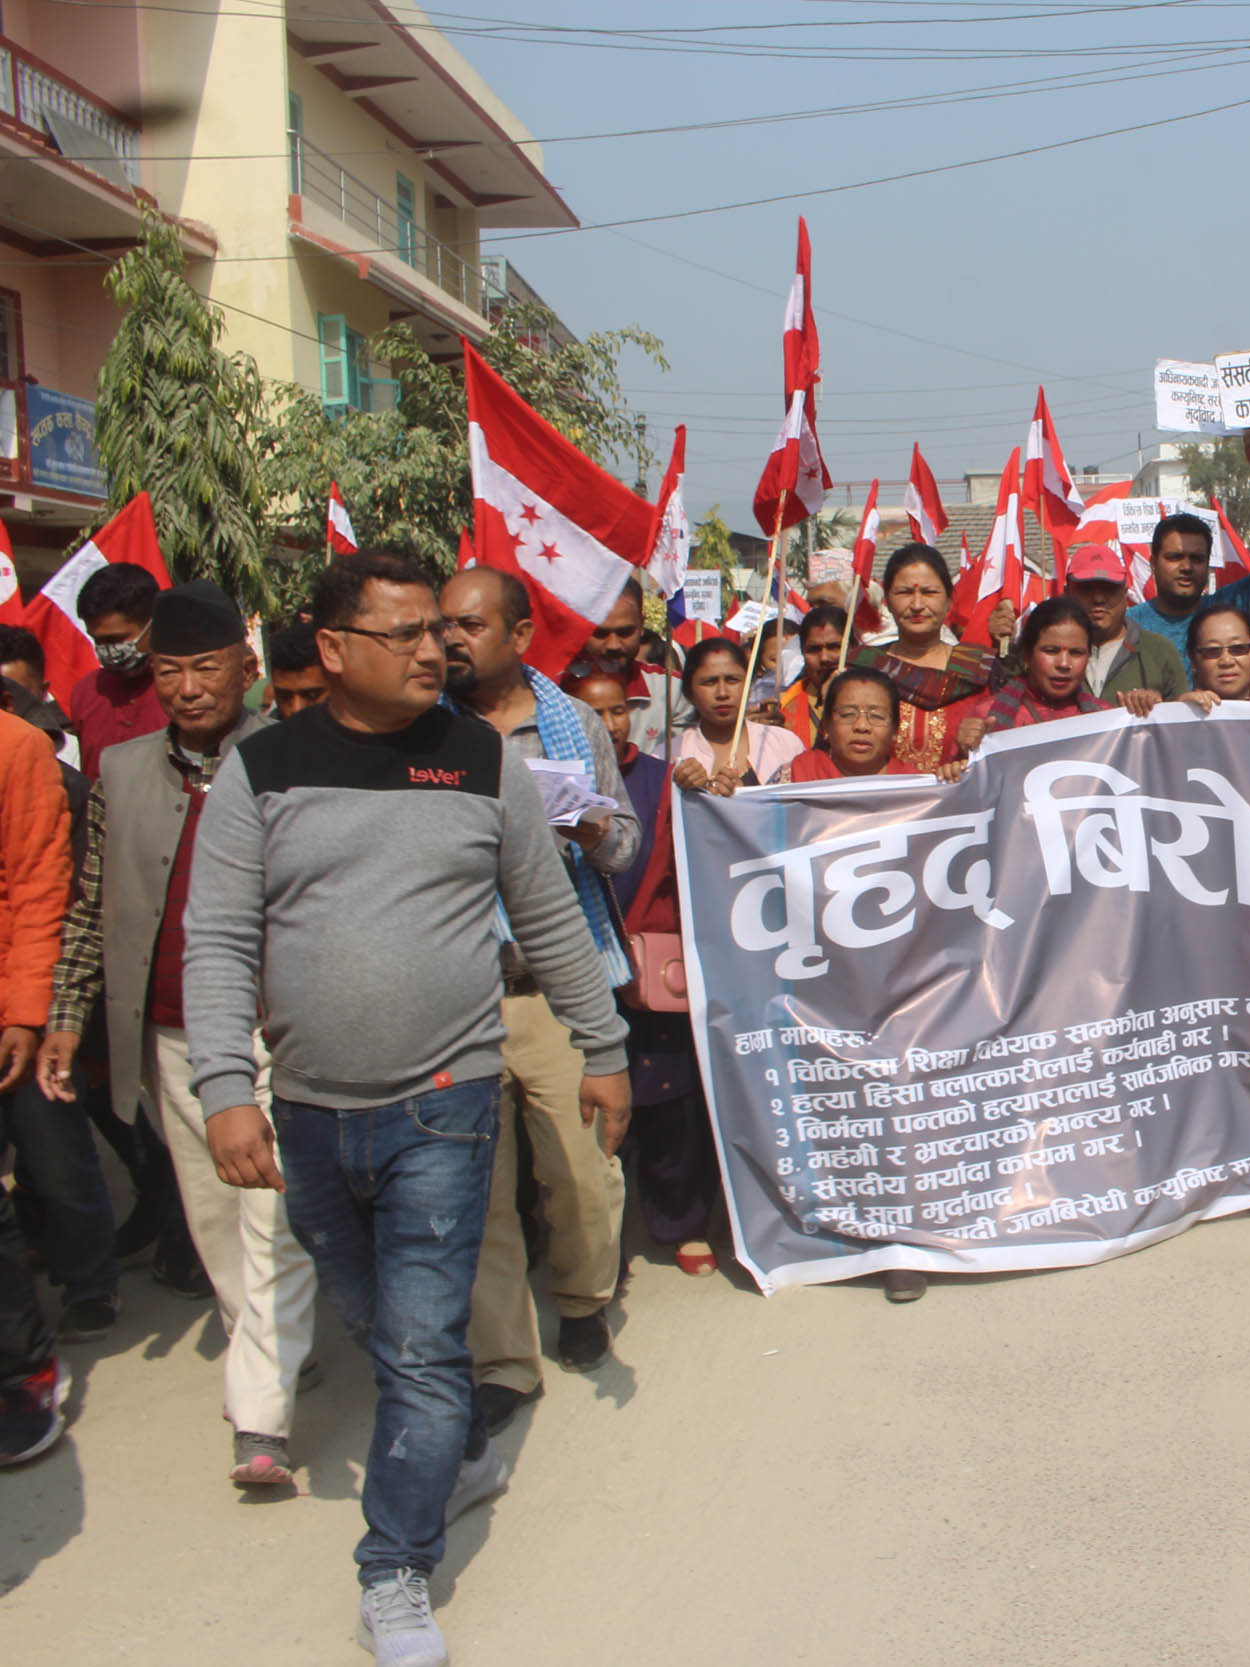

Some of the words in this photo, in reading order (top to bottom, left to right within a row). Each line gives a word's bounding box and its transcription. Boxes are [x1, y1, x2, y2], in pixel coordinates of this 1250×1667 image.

[787, 1057, 899, 1084] चिकित्सा
[905, 1047, 971, 1073] शिक्षा
[1160, 997, 1240, 1026] अनुसार
[791, 1090, 857, 1114] हत्या
[1181, 1026, 1213, 1048] गर
[795, 1115, 885, 1143] निर्मला
[891, 1099, 977, 1134] पन्तको
[981, 1071, 1118, 1121] हत्यारालाई
[1120, 1053, 1214, 1092] सार्वजनिक
[885, 1145, 907, 1166] र
[1127, 1096, 1156, 1118] गर
[810, 1171, 908, 1200] संसदीय
[914, 1160, 992, 1192] मर्यादा
[996, 1143, 1077, 1175] कायम
[1081, 1133, 1125, 1156] गर
[920, 1186, 1014, 1224] मुर्दावाद
